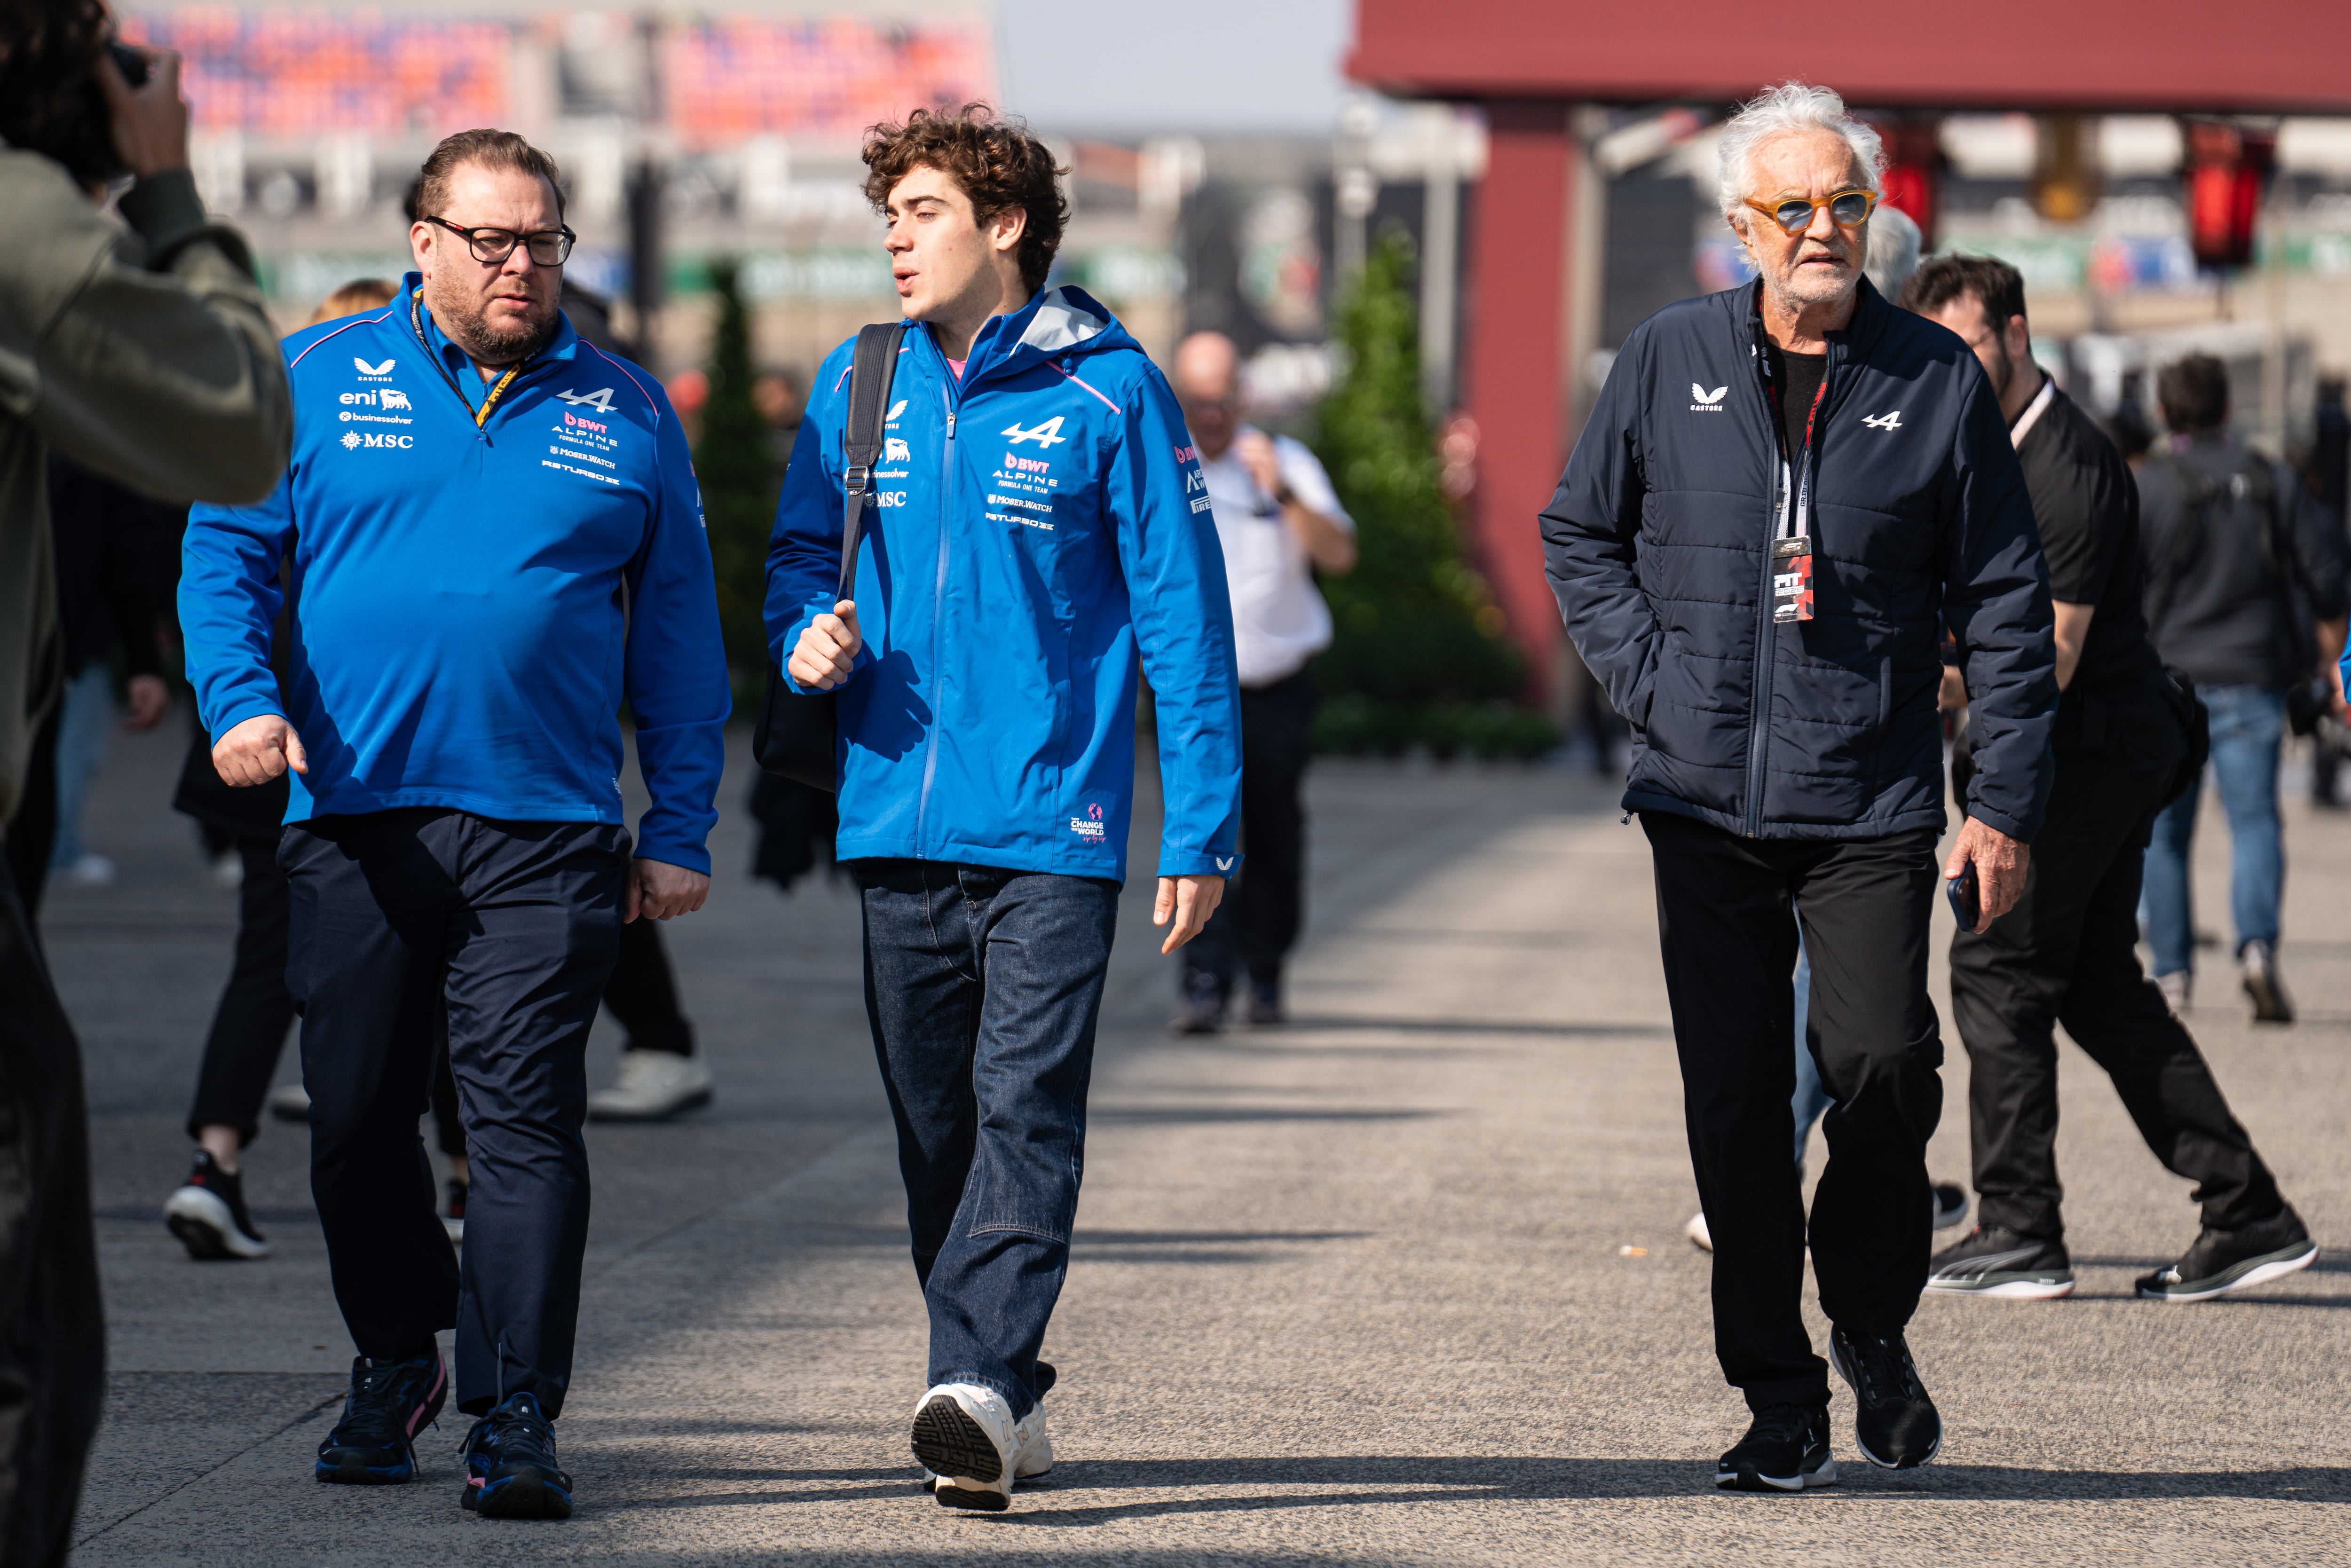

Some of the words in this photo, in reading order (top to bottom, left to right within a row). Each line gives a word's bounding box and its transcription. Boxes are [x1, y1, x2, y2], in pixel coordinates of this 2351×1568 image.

[339, 389, 377, 406] eni
[353, 412, 413, 424] businessolver
[577, 417, 607, 434] BWT
[363, 433, 413, 449] MSC
[551, 425, 618, 447] ALPINE
[559, 434, 583, 444] FORMULA
[597, 443, 610, 452] TEAM
[1018, 457, 1050, 474] BWT
[992, 470, 1058, 487] ALPINE
[998, 480, 1021, 489] FORMULA
[876, 491, 907, 507] MSC
[1190, 495, 1212, 514] PIRE
[1774, 572, 1802, 588] PIT
[1071, 820, 1104, 829] CHANGE
[1092, 834, 1097, 844] by
